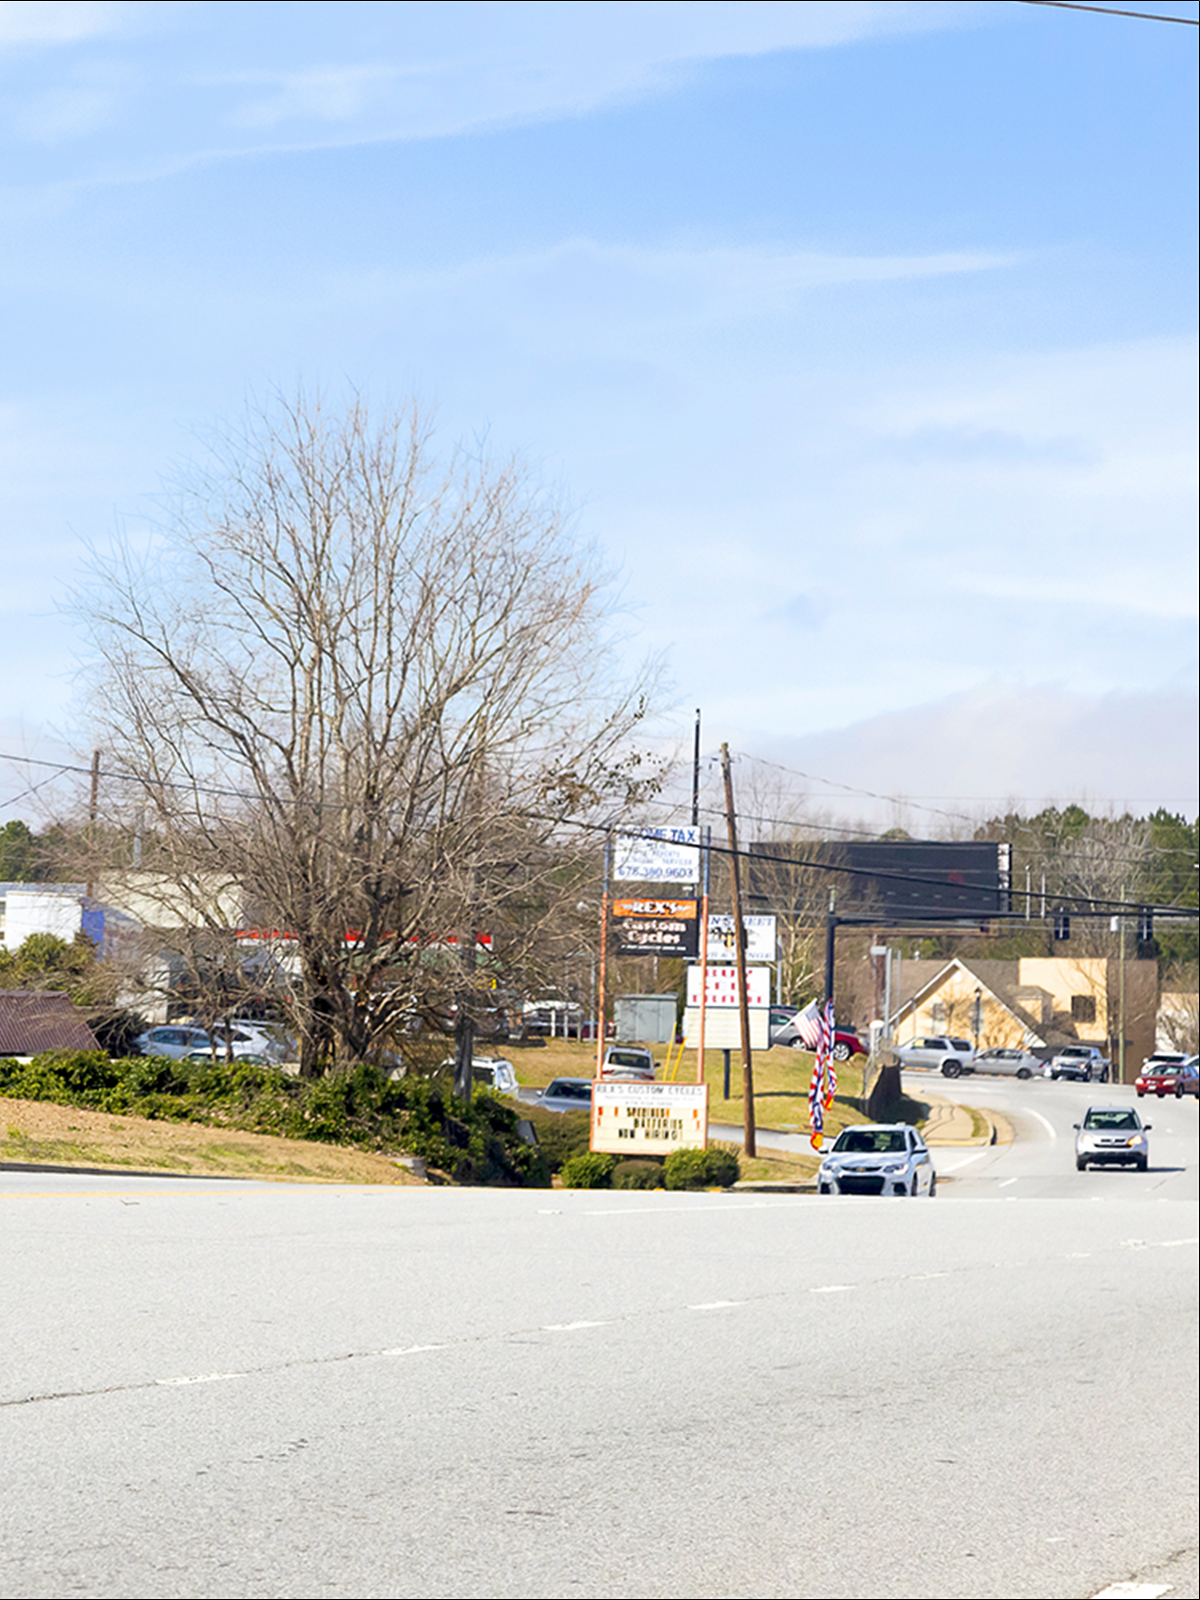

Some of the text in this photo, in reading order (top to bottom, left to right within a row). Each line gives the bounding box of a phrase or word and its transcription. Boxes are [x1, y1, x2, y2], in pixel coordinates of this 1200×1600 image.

[670, 829, 696, 842] TAX
[633, 901, 678, 914] REX'S
[623, 918, 687, 932] Custom
[628, 930, 680, 944] Cycles
[628, 1086, 664, 1095] CUSTOM
[619, 1129, 636, 1139] NOW
